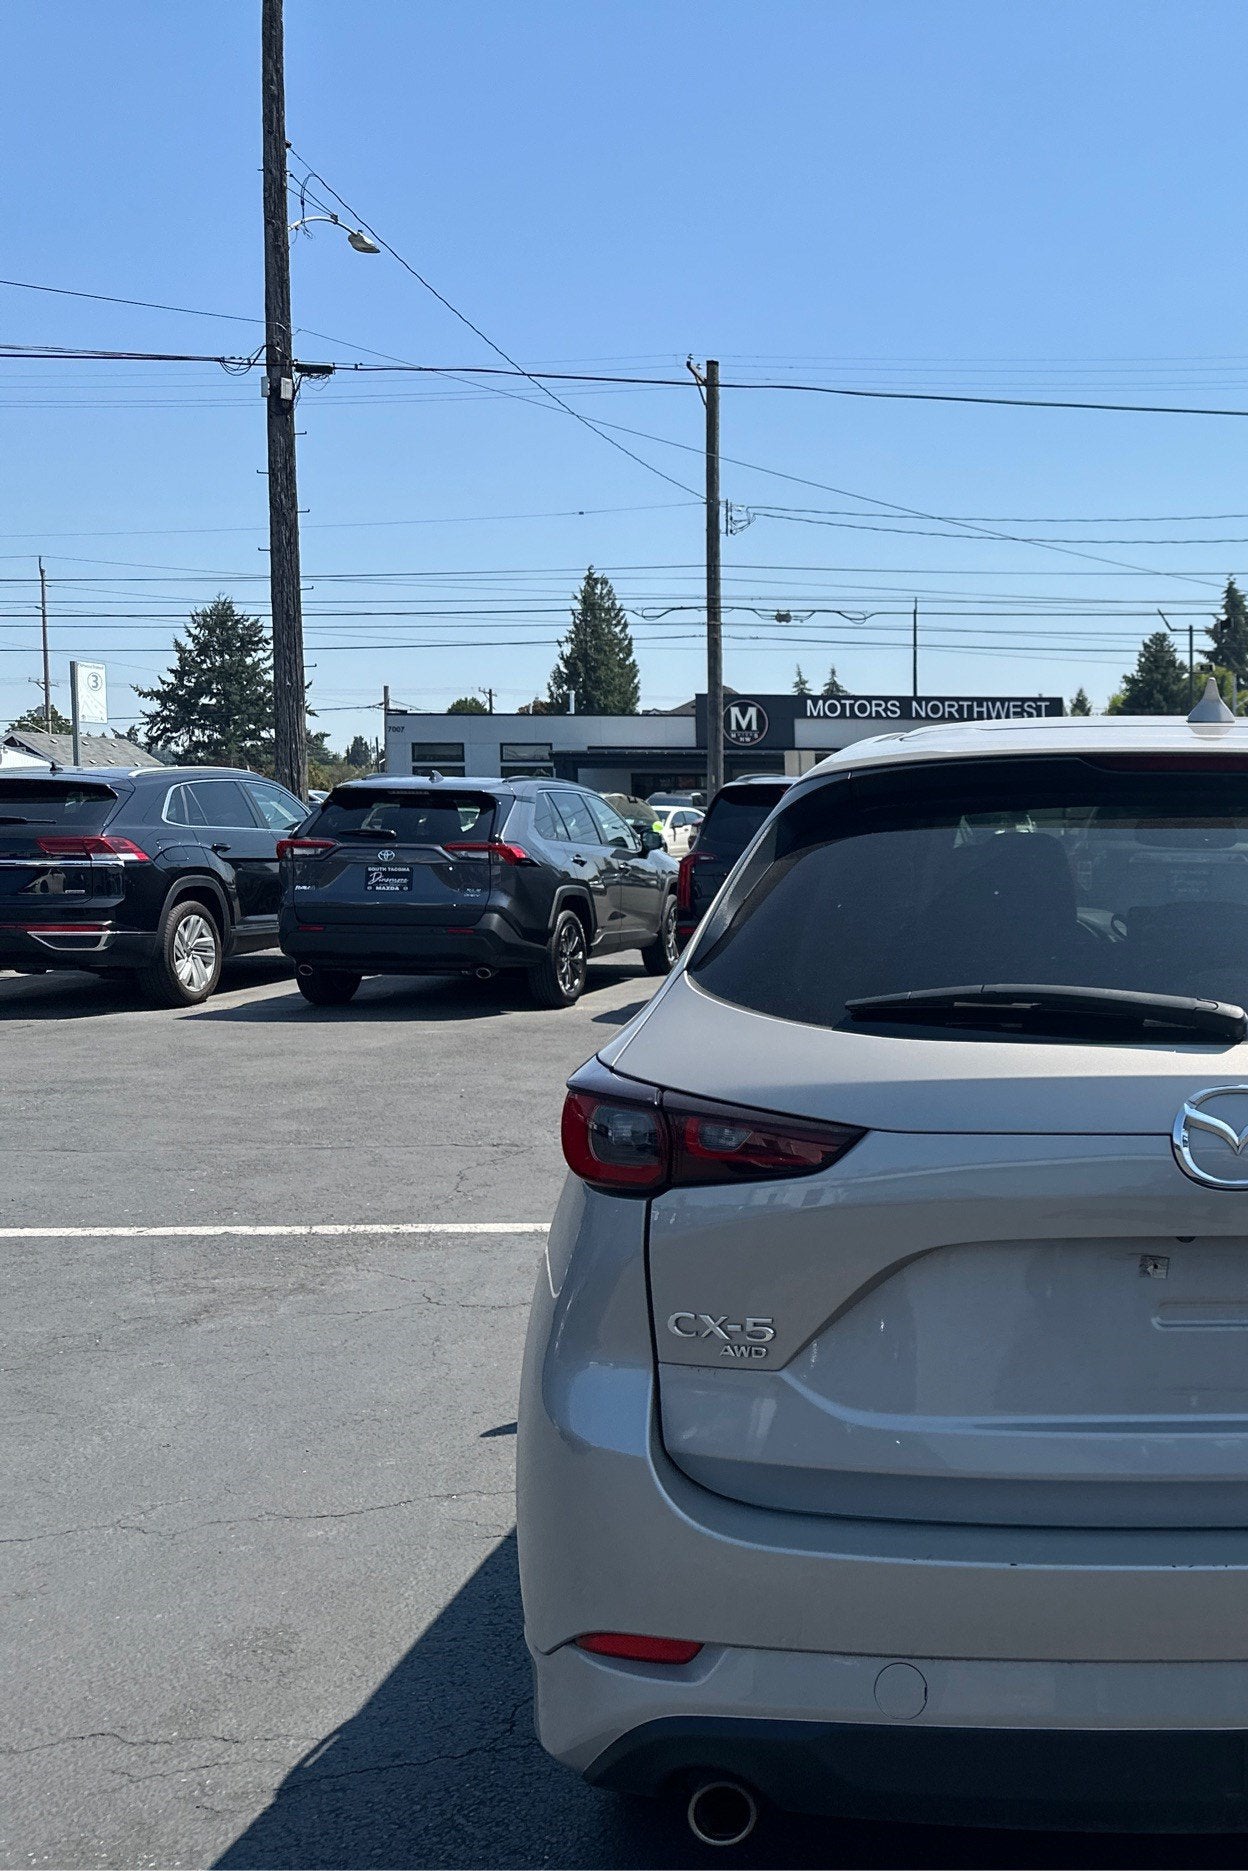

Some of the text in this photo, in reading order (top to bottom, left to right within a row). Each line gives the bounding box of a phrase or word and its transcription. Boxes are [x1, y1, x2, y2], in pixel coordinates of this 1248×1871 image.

[91, 674, 99, 689] 3
[730, 706, 758, 731] M
[806, 699, 1050, 719] MOTORS NORTHWEST
[667, 1311, 775, 1342] CX-5
[719, 1344, 768, 1359] AWD
